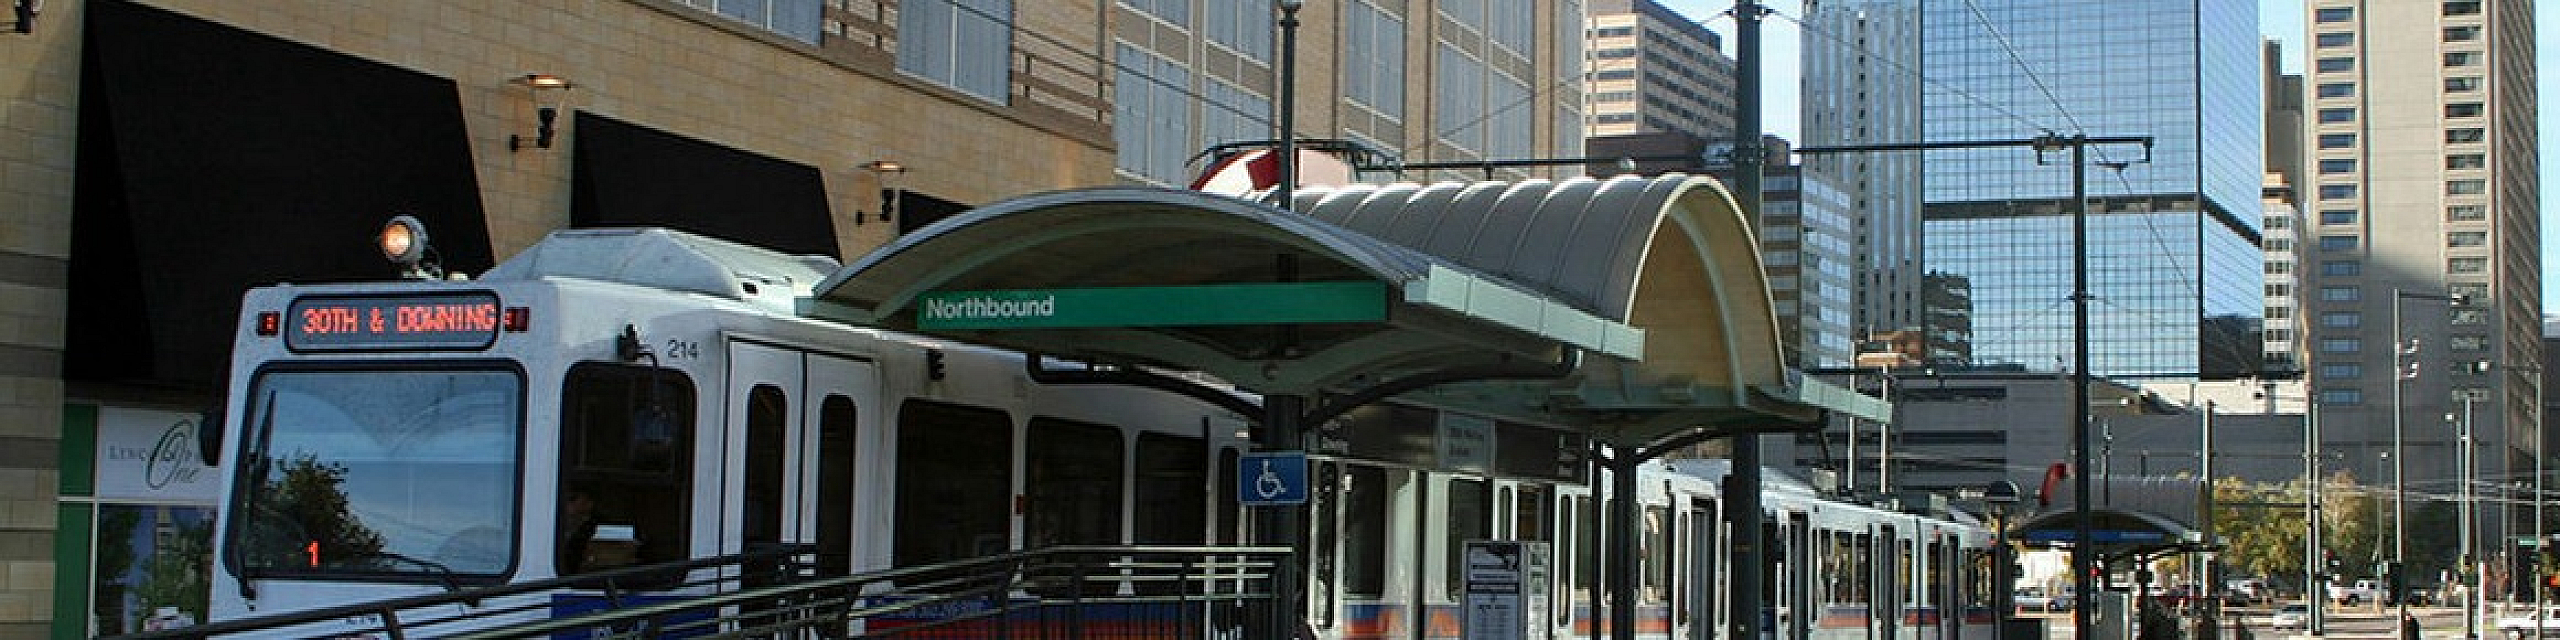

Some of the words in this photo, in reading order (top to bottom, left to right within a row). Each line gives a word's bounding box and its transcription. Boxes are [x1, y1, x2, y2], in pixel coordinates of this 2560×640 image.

[302, 308, 358, 333] 30TH
[369, 307, 384, 333] &
[397, 303, 497, 332] DOWNING
[925, 296, 1055, 320] Northbound
[667, 339, 699, 359] 214
[305, 540, 320, 568] 1
